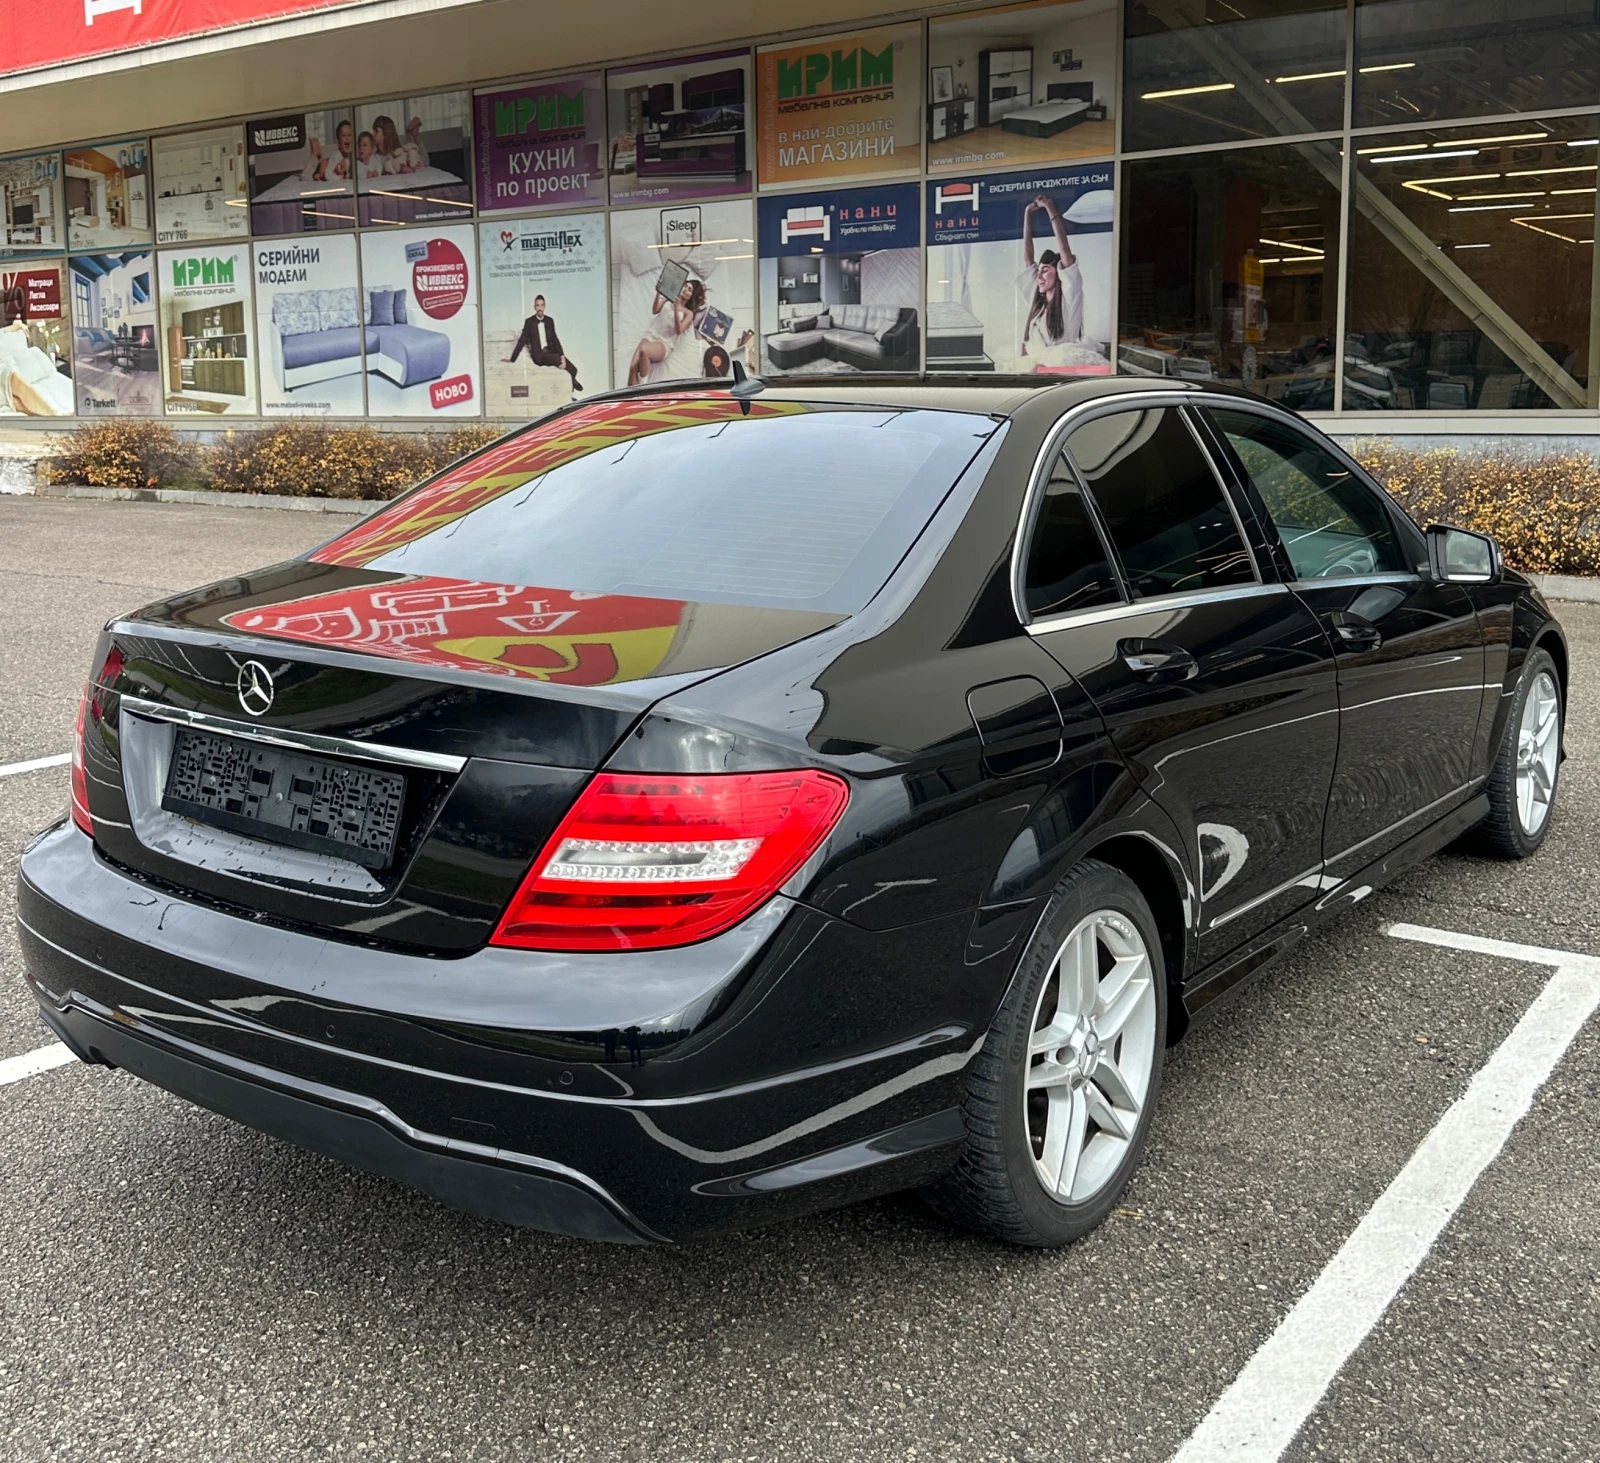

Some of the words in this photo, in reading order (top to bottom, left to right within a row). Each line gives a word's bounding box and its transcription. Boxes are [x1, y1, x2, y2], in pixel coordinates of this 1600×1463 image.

[777, 42, 894, 99] ИРИМ
[778, 99, 830, 114] мебелна
[832, 91, 894, 108] компания
[495, 88, 585, 137] ИРИМ
[265, 126, 298, 140] ИВВЕКС
[778, 132, 787, 143] в
[508, 146, 575, 175] КУХНИ
[778, 135, 895, 168] МАГАЗИНИ
[931, 151, 1005, 166] www.irimbg.com
[496, 180, 519, 198] по
[525, 173, 591, 199] проект
[612, 186, 669, 199] www.irimbg.com
[989, 182, 1026, 194] ЕКСПЕРТИ
[1032, 176, 1080, 189] ПРОДУКТИТЕ
[1081, 176, 1090, 184] ЗА
[666, 219, 697, 233] iSleep
[158, 231, 174, 242] CITY
[175, 229, 188, 240] 766
[520, 231, 583, 251] magniflex
[258, 245, 320, 267] СЕРИЙНИ
[172, 255, 235, 287] ИРИМ
[455, 263, 464, 271] ОТ
[258, 268, 307, 285] МОДЕЛИ
[428, 273, 464, 286] ИВВЕКС
[434, 382, 468, 402] НОВО
[91, 399, 117, 408] Tarkett
[167, 402, 183, 412] CITY
[1010, 953, 1046, 1065] Continental
